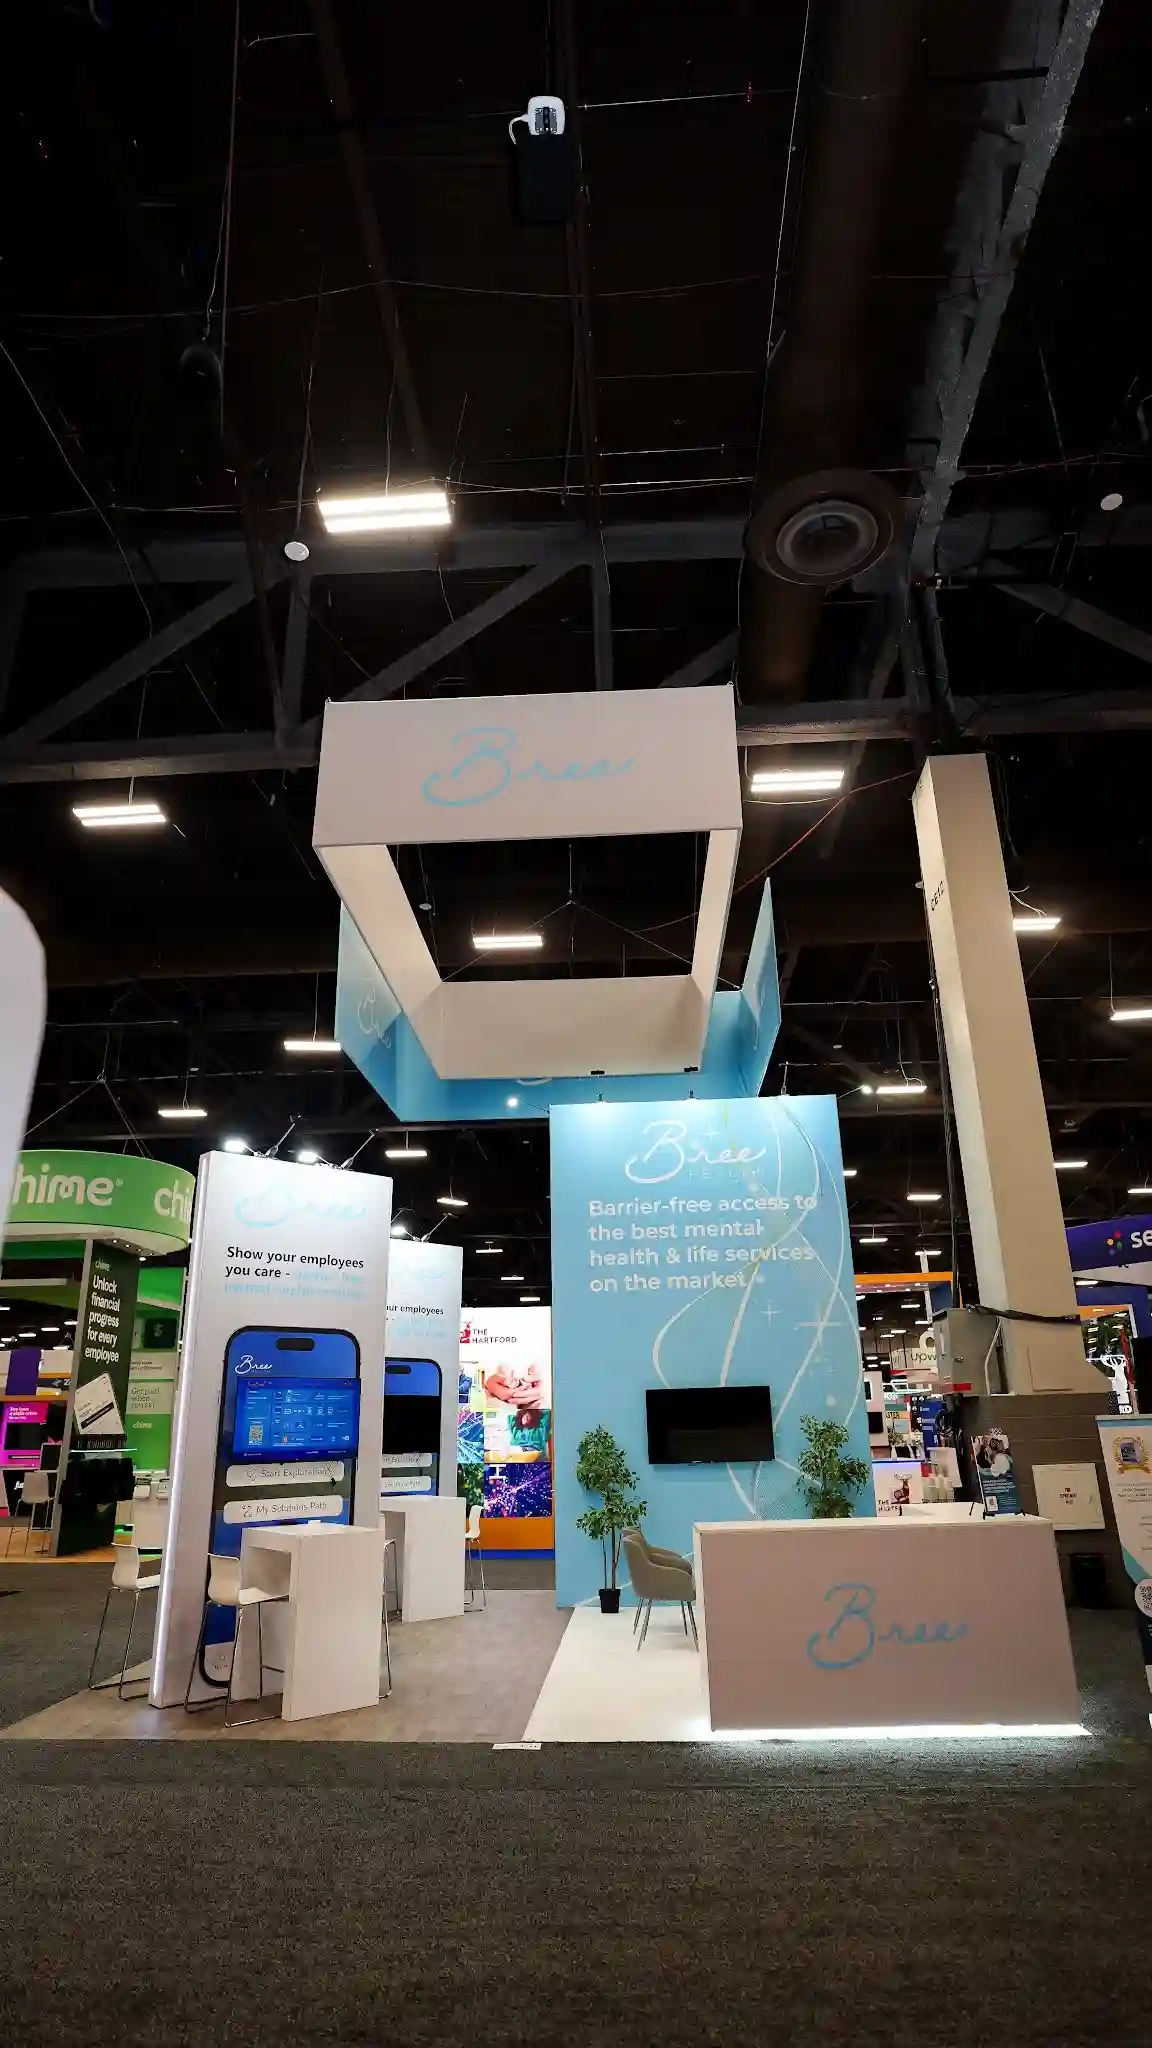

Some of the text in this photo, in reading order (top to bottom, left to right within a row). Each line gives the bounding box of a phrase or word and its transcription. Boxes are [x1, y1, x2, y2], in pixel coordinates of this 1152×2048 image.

[422, 727, 634, 807] Bree
[625, 1120, 767, 1184] Bree
[588, 1194, 818, 1217] Barrier-free access to
[588, 1219, 763, 1242] the best mental
[227, 1246, 364, 1270] Show your employees
[589, 1245, 815, 1267] health & life services
[225, 1265, 250, 1278] you
[254, 1266, 281, 1278] care
[93, 1275, 117, 1294] Unlock
[590, 1277, 618, 1293] on
[624, 1274, 661, 1291] the
[91, 1292, 120, 1312] financial
[401, 1305, 444, 1316] employees
[88, 1311, 119, 1327] progress
[87, 1326, 117, 1348] for every
[472, 1336, 517, 1344] HARTFORD
[85, 1347, 119, 1364] employee
[235, 1354, 272, 1374] Bree
[910, 1352, 936, 1364] upw
[256, 1506, 269, 1515] My
[272, 1503, 308, 1513] Solutions
[807, 1582, 970, 1670] Bree
